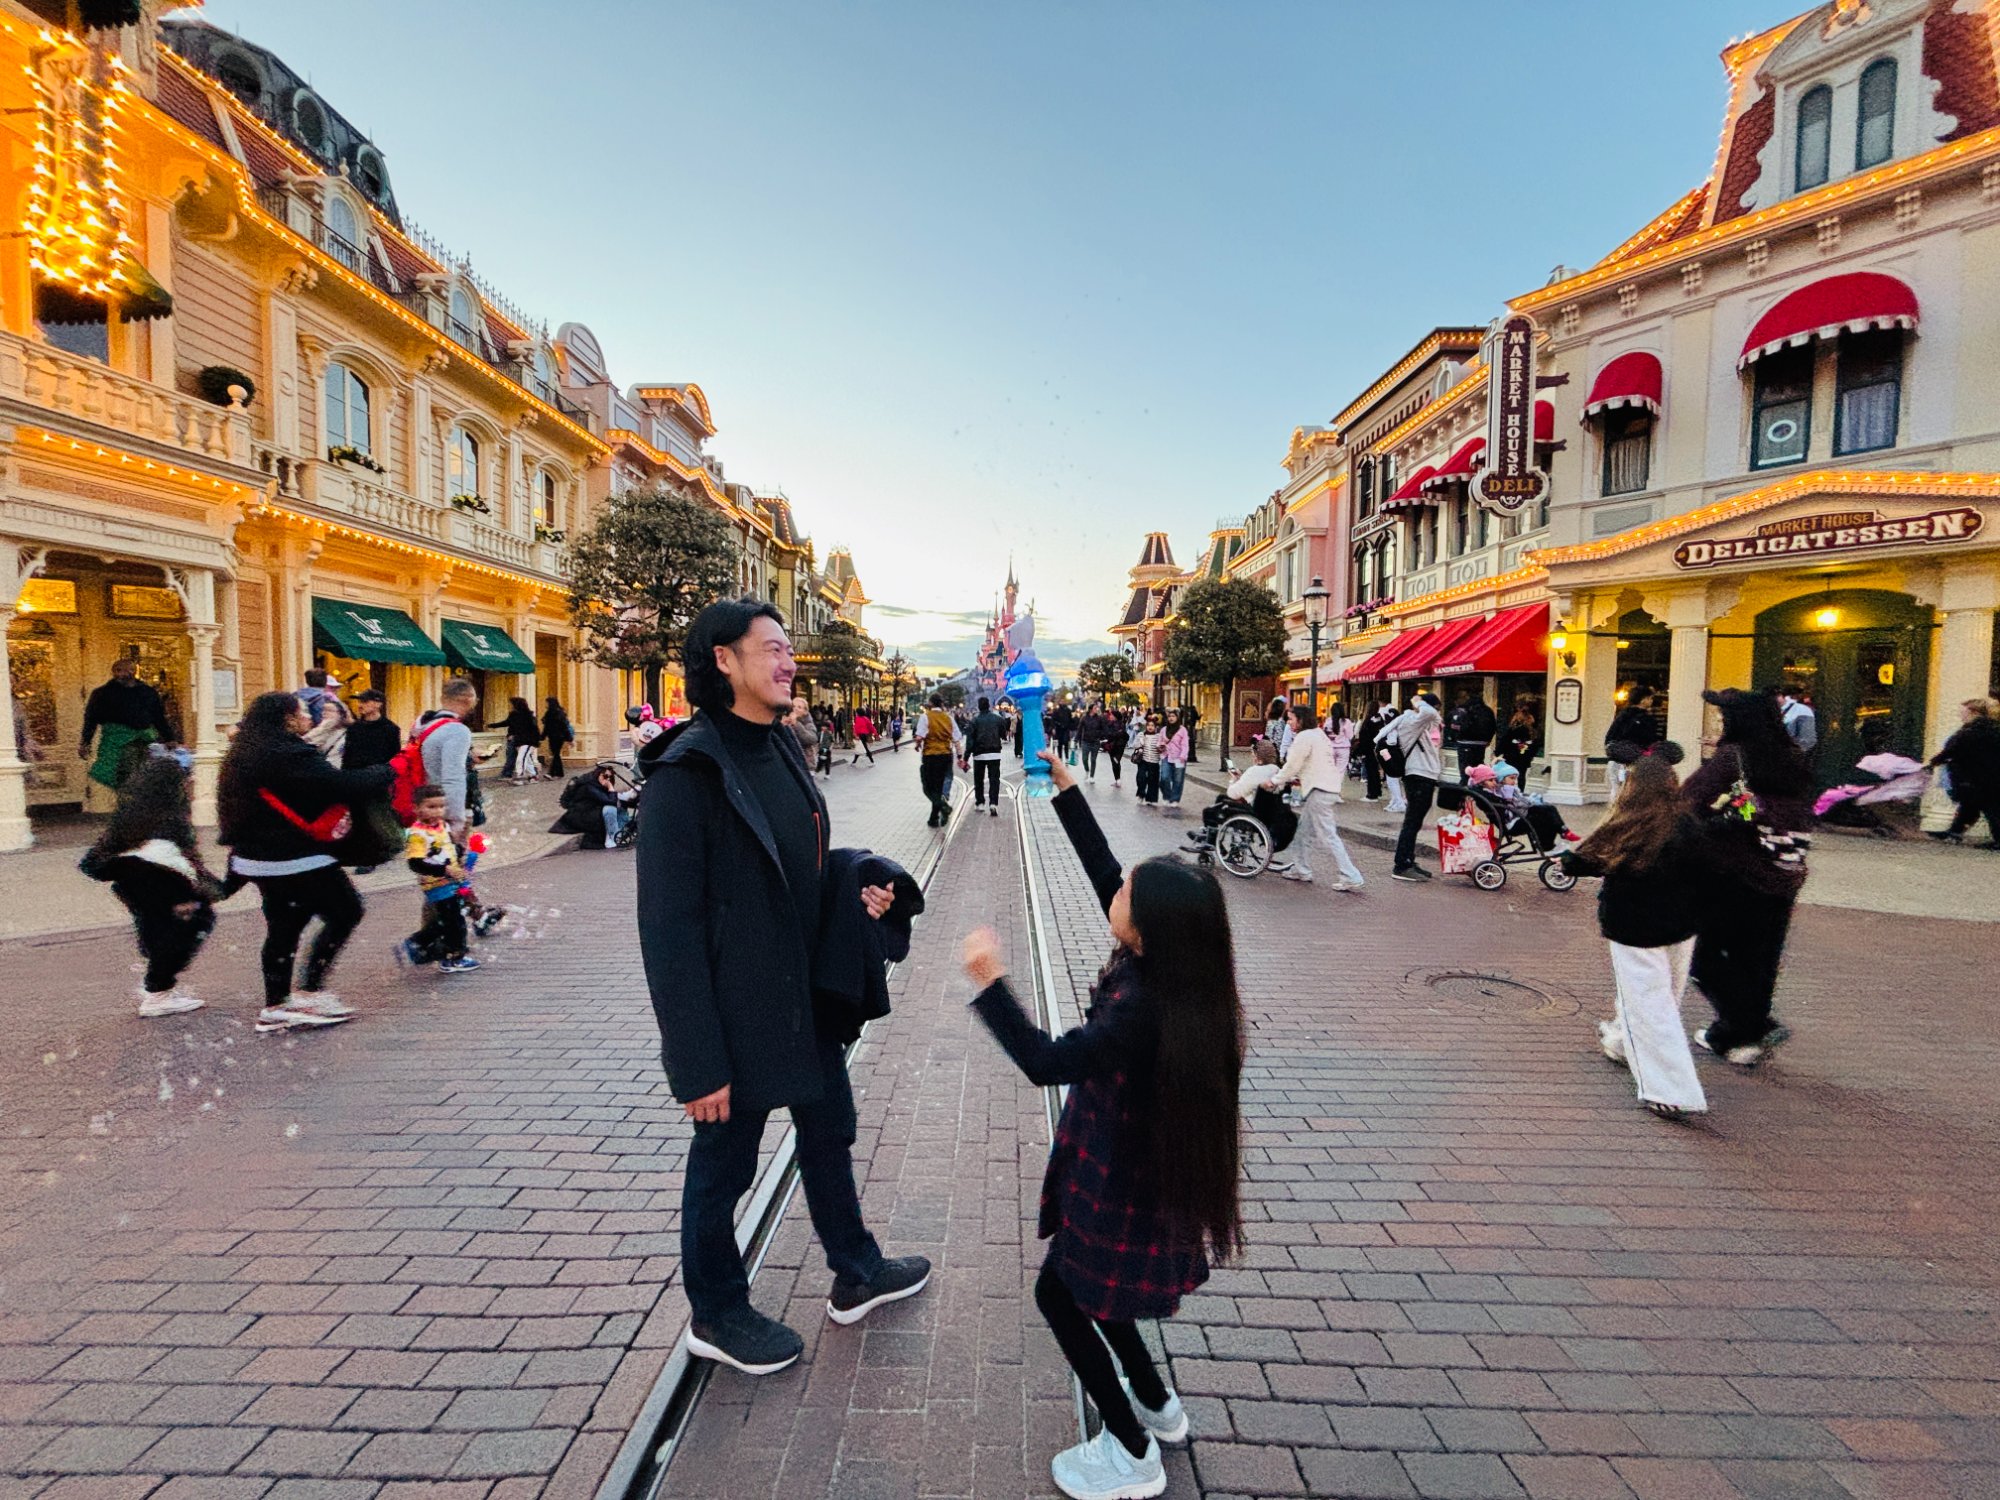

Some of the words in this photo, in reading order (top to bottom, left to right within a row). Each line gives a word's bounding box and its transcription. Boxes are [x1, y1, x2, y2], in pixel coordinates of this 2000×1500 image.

[1508, 331, 1526, 408] MARKET
[1506, 414, 1521, 477] HOUSE
[1488, 479, 1534, 493] DELI
[1686, 512, 1967, 563] DELICATESSEN
[1761, 515, 1819, 536] MARKET
[1821, 512, 1873, 528] HOUSE
